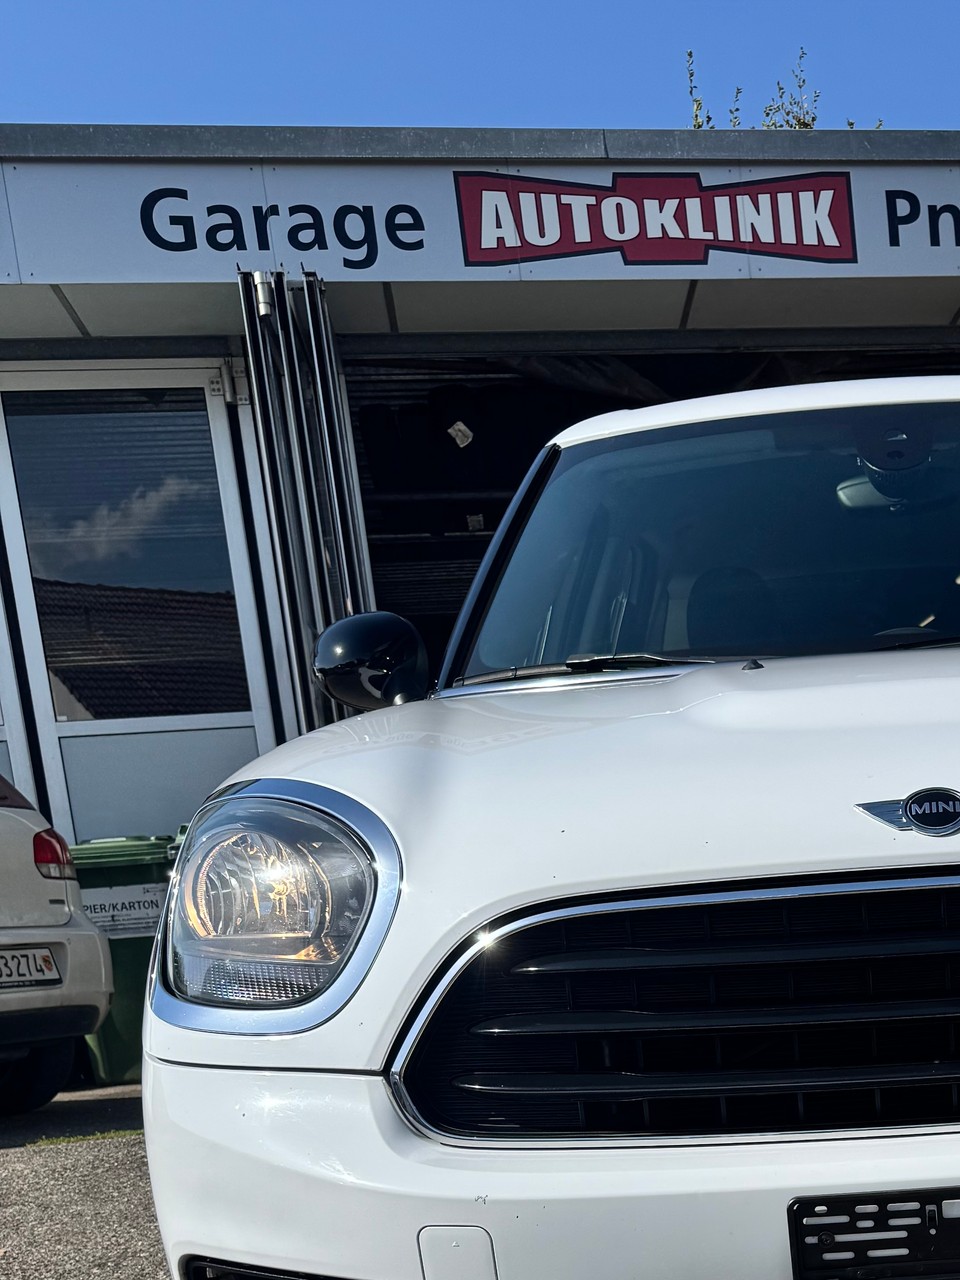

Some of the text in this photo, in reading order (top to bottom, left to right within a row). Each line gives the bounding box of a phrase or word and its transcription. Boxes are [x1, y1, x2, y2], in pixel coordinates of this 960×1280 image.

[139, 187, 426, 270] Garage
[479, 189, 841, 250] AUTOKLINIK
[911, 800, 960, 816] MINI
[0, 953, 45, 979] 3274
